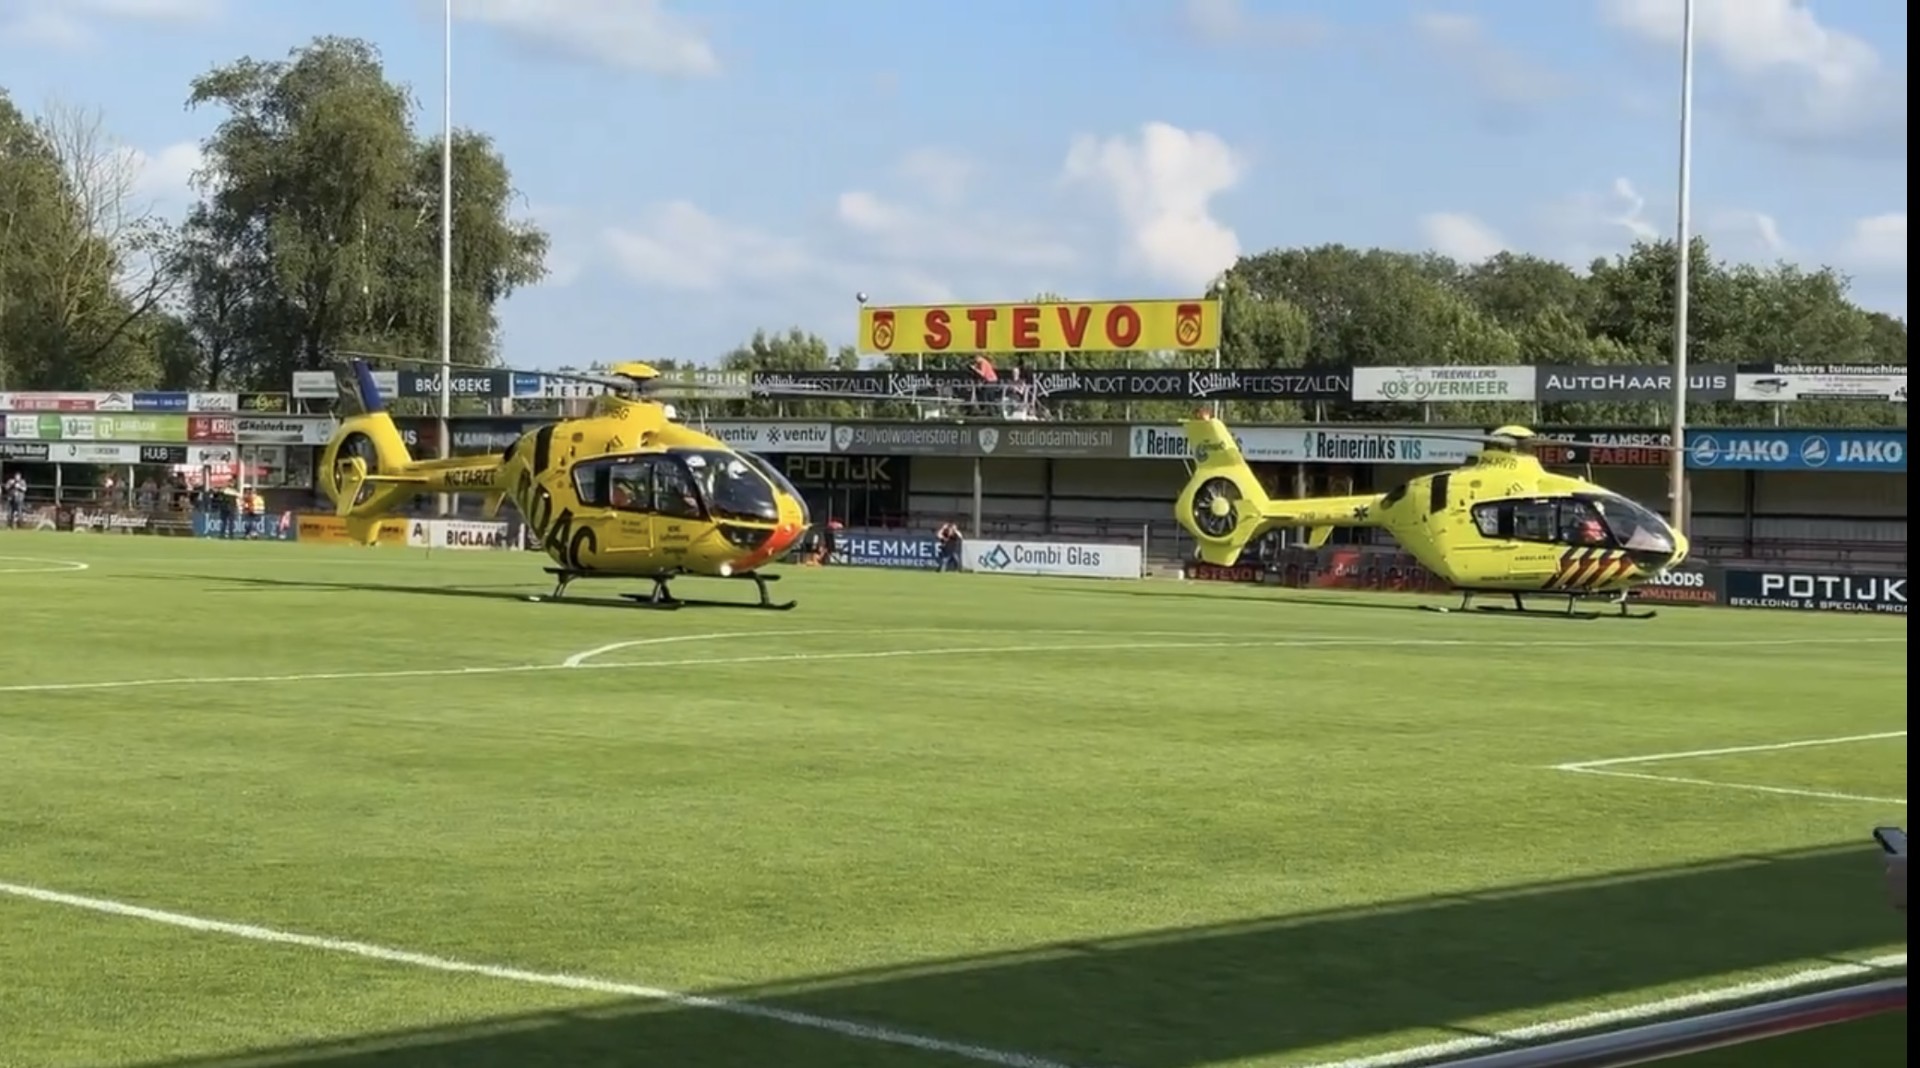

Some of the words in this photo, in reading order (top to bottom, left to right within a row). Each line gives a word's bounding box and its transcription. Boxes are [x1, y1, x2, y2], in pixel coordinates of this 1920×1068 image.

[923, 304, 1141, 350] STEVO
[1431, 369, 1497, 379] TWEEWIELERS
[1774, 364, 1825, 374] Reekers
[416, 373, 492, 392] BROKBEKE
[888, 373, 934, 397] Kollink
[1033, 372, 1082, 397] Kollink
[1084, 376, 1127, 392] NEXT
[1131, 376, 1181, 392] DOOR
[1189, 371, 1242, 397] Kollink
[1244, 375, 1349, 393] FEESTZALEN
[1377, 381, 1409, 397] JOS
[1413, 380, 1509, 397] OVERMEER
[1545, 374, 1727, 389] AUTOHAARUIS
[715, 427, 758, 441] ventiv
[783, 427, 827, 441] ventiv
[1008, 429, 1112, 446] studiodamhuis.nl
[1589, 433, 1672, 446] TEAMSPOR
[143, 447, 169, 460] HUUB
[1401, 439, 1422, 460] VIS
[1724, 440, 1789, 462] JAKO
[1836, 440, 1903, 463] JAKO
[786, 456, 891, 481] POTIJK
[1013, 545, 1063, 566] Combi
[1067, 547, 1101, 567] Glas
[1201, 566, 1251, 580] STEVO
[1762, 573, 1907, 601] POTIJK
[1730, 597, 1799, 608] BEKLEDING
[1804, 599, 1814, 608] &
[1819, 601, 1873, 611] SPECIAL
